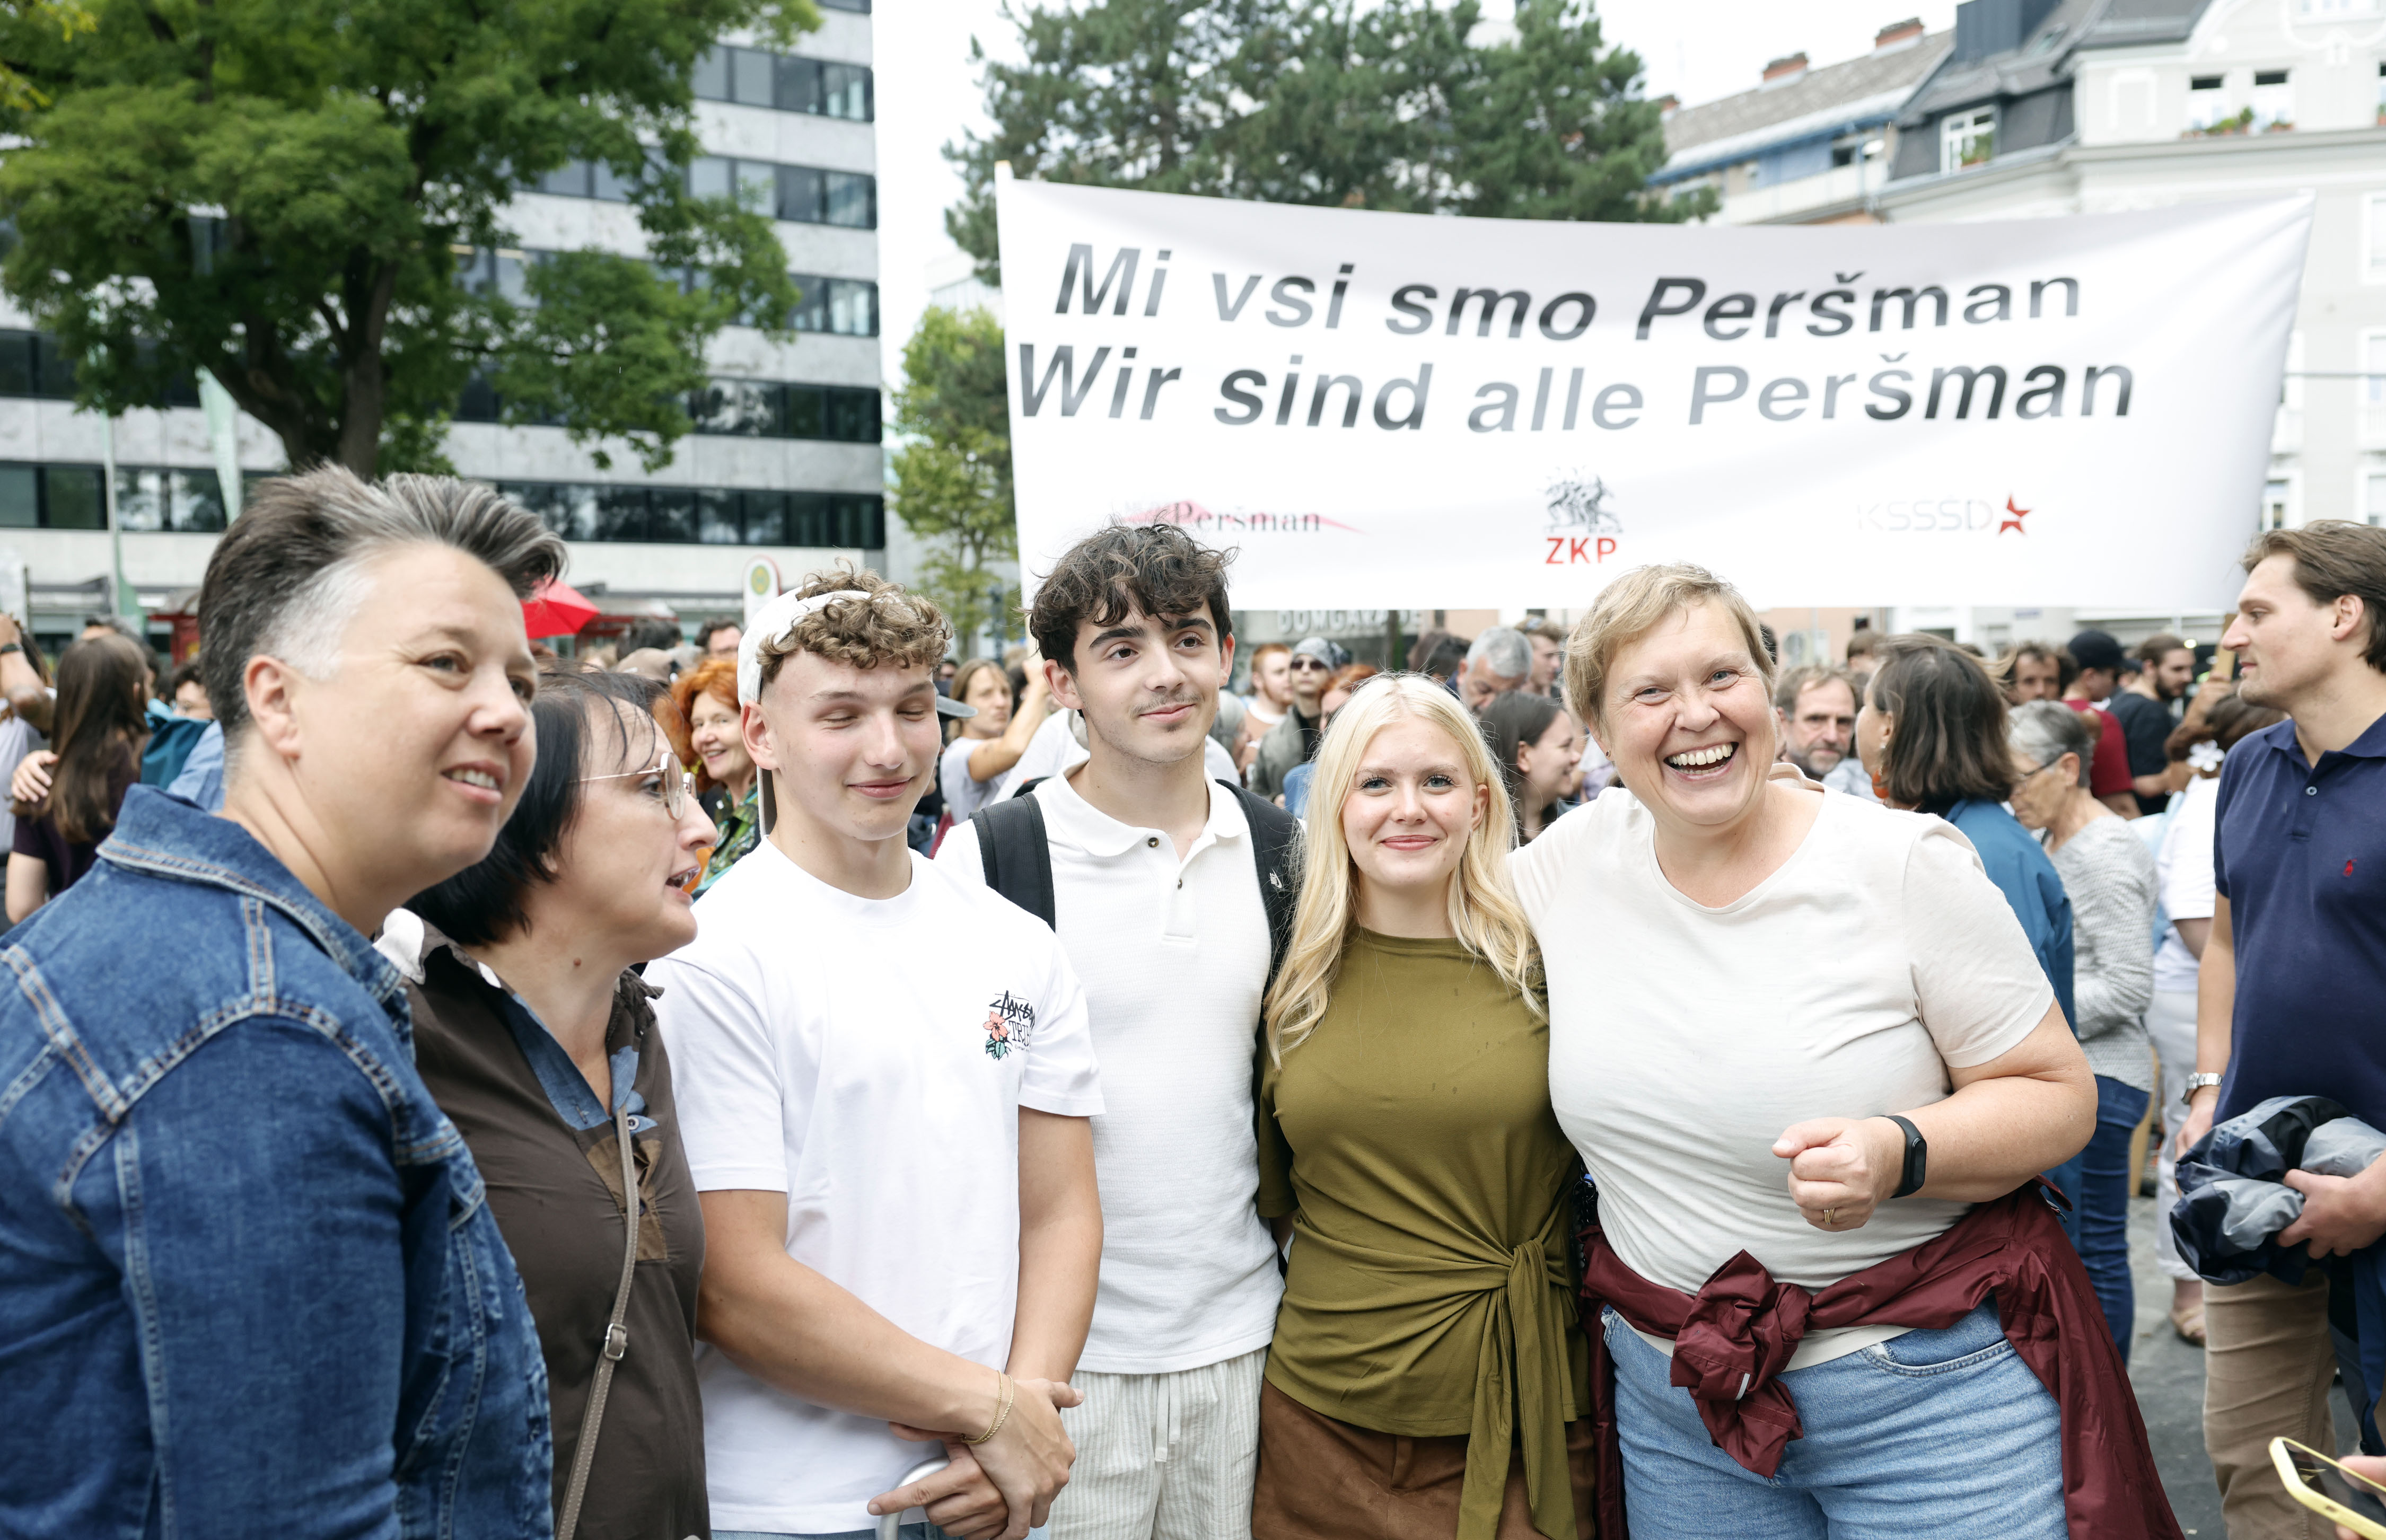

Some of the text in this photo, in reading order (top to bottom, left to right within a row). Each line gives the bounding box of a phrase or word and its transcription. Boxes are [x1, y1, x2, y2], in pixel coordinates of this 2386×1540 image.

[1054, 243, 2080, 341] Mi vsi smo Peršman
[1019, 342, 2134, 433] Wir sind alle Peršman
[1174, 500, 1321, 532] Peršman
[1545, 536, 1617, 565] ZKP
[1008, 1020, 1032, 1047] TRIB
